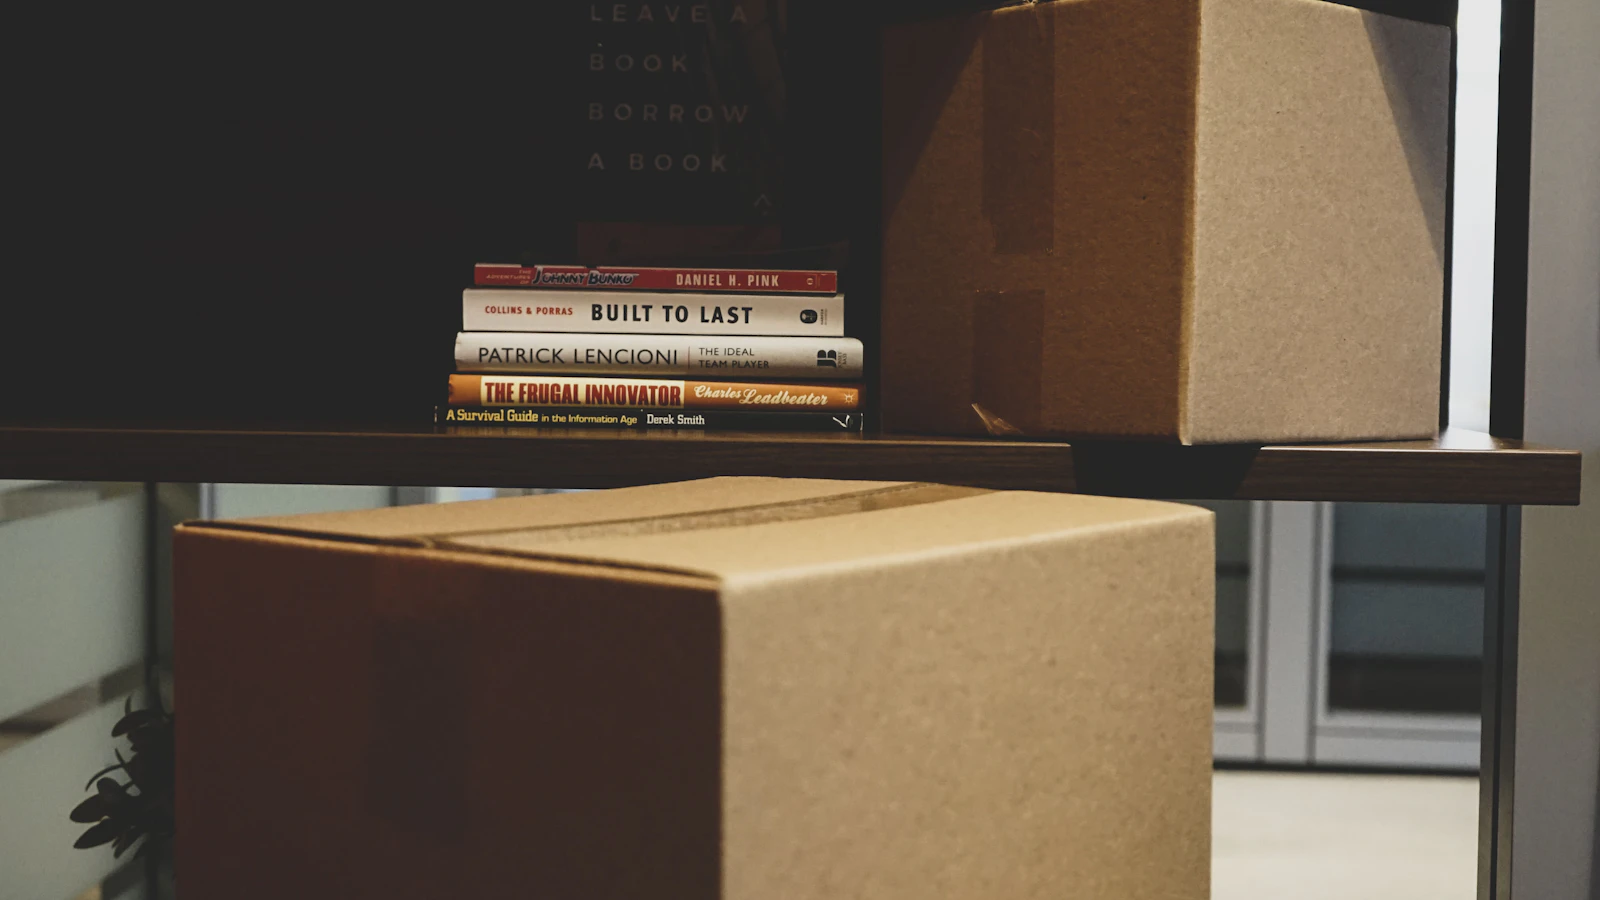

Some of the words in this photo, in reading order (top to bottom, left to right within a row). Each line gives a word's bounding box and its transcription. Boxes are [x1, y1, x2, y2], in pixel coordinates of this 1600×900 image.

[590, 3, 708, 23] LEAVE
[730, 4, 748, 23] A
[589, 52, 688, 72] BOOK
[588, 102, 749, 123] BORROW
[587, 152, 605, 170] A
[629, 152, 728, 173] BOOK
[532, 266, 586, 285] JOHNNY
[587, 271, 640, 286] BUNKO
[676, 273, 722, 286] DANIEL
[728, 274, 741, 286] H.
[747, 274, 780, 287] PINK
[484, 305, 522, 314] COLLINS
[526, 306, 532, 315] &
[535, 306, 574, 316] PORRAS
[591, 303, 654, 322] BUILT
[662, 305, 689, 323] TO
[700, 306, 753, 324] LAST
[478, 347, 565, 364] PATRICK
[574, 348, 678, 365] LENCIONI
[698, 347, 720, 356] THE
[723, 347, 755, 356] IDEAL
[698, 359, 728, 368] TEAM
[731, 360, 770, 369] PLAYER
[484, 382, 515, 404] THE
[518, 383, 581, 405] FRUGAL
[585, 384, 681, 406] INNOVATOR
[693, 384, 742, 399] Charles
[739, 388, 829, 406] Leadbeater
[446, 409, 456, 421] A
[457, 408, 505, 422] Survival
[506, 409, 539, 422] Guide
[541, 414, 550, 422] in
[552, 414, 567, 423] the
[568, 414, 618, 423] Information
[620, 414, 638, 426] Age
[646, 413, 675, 425] Derek
[677, 414, 706, 425] Smith
